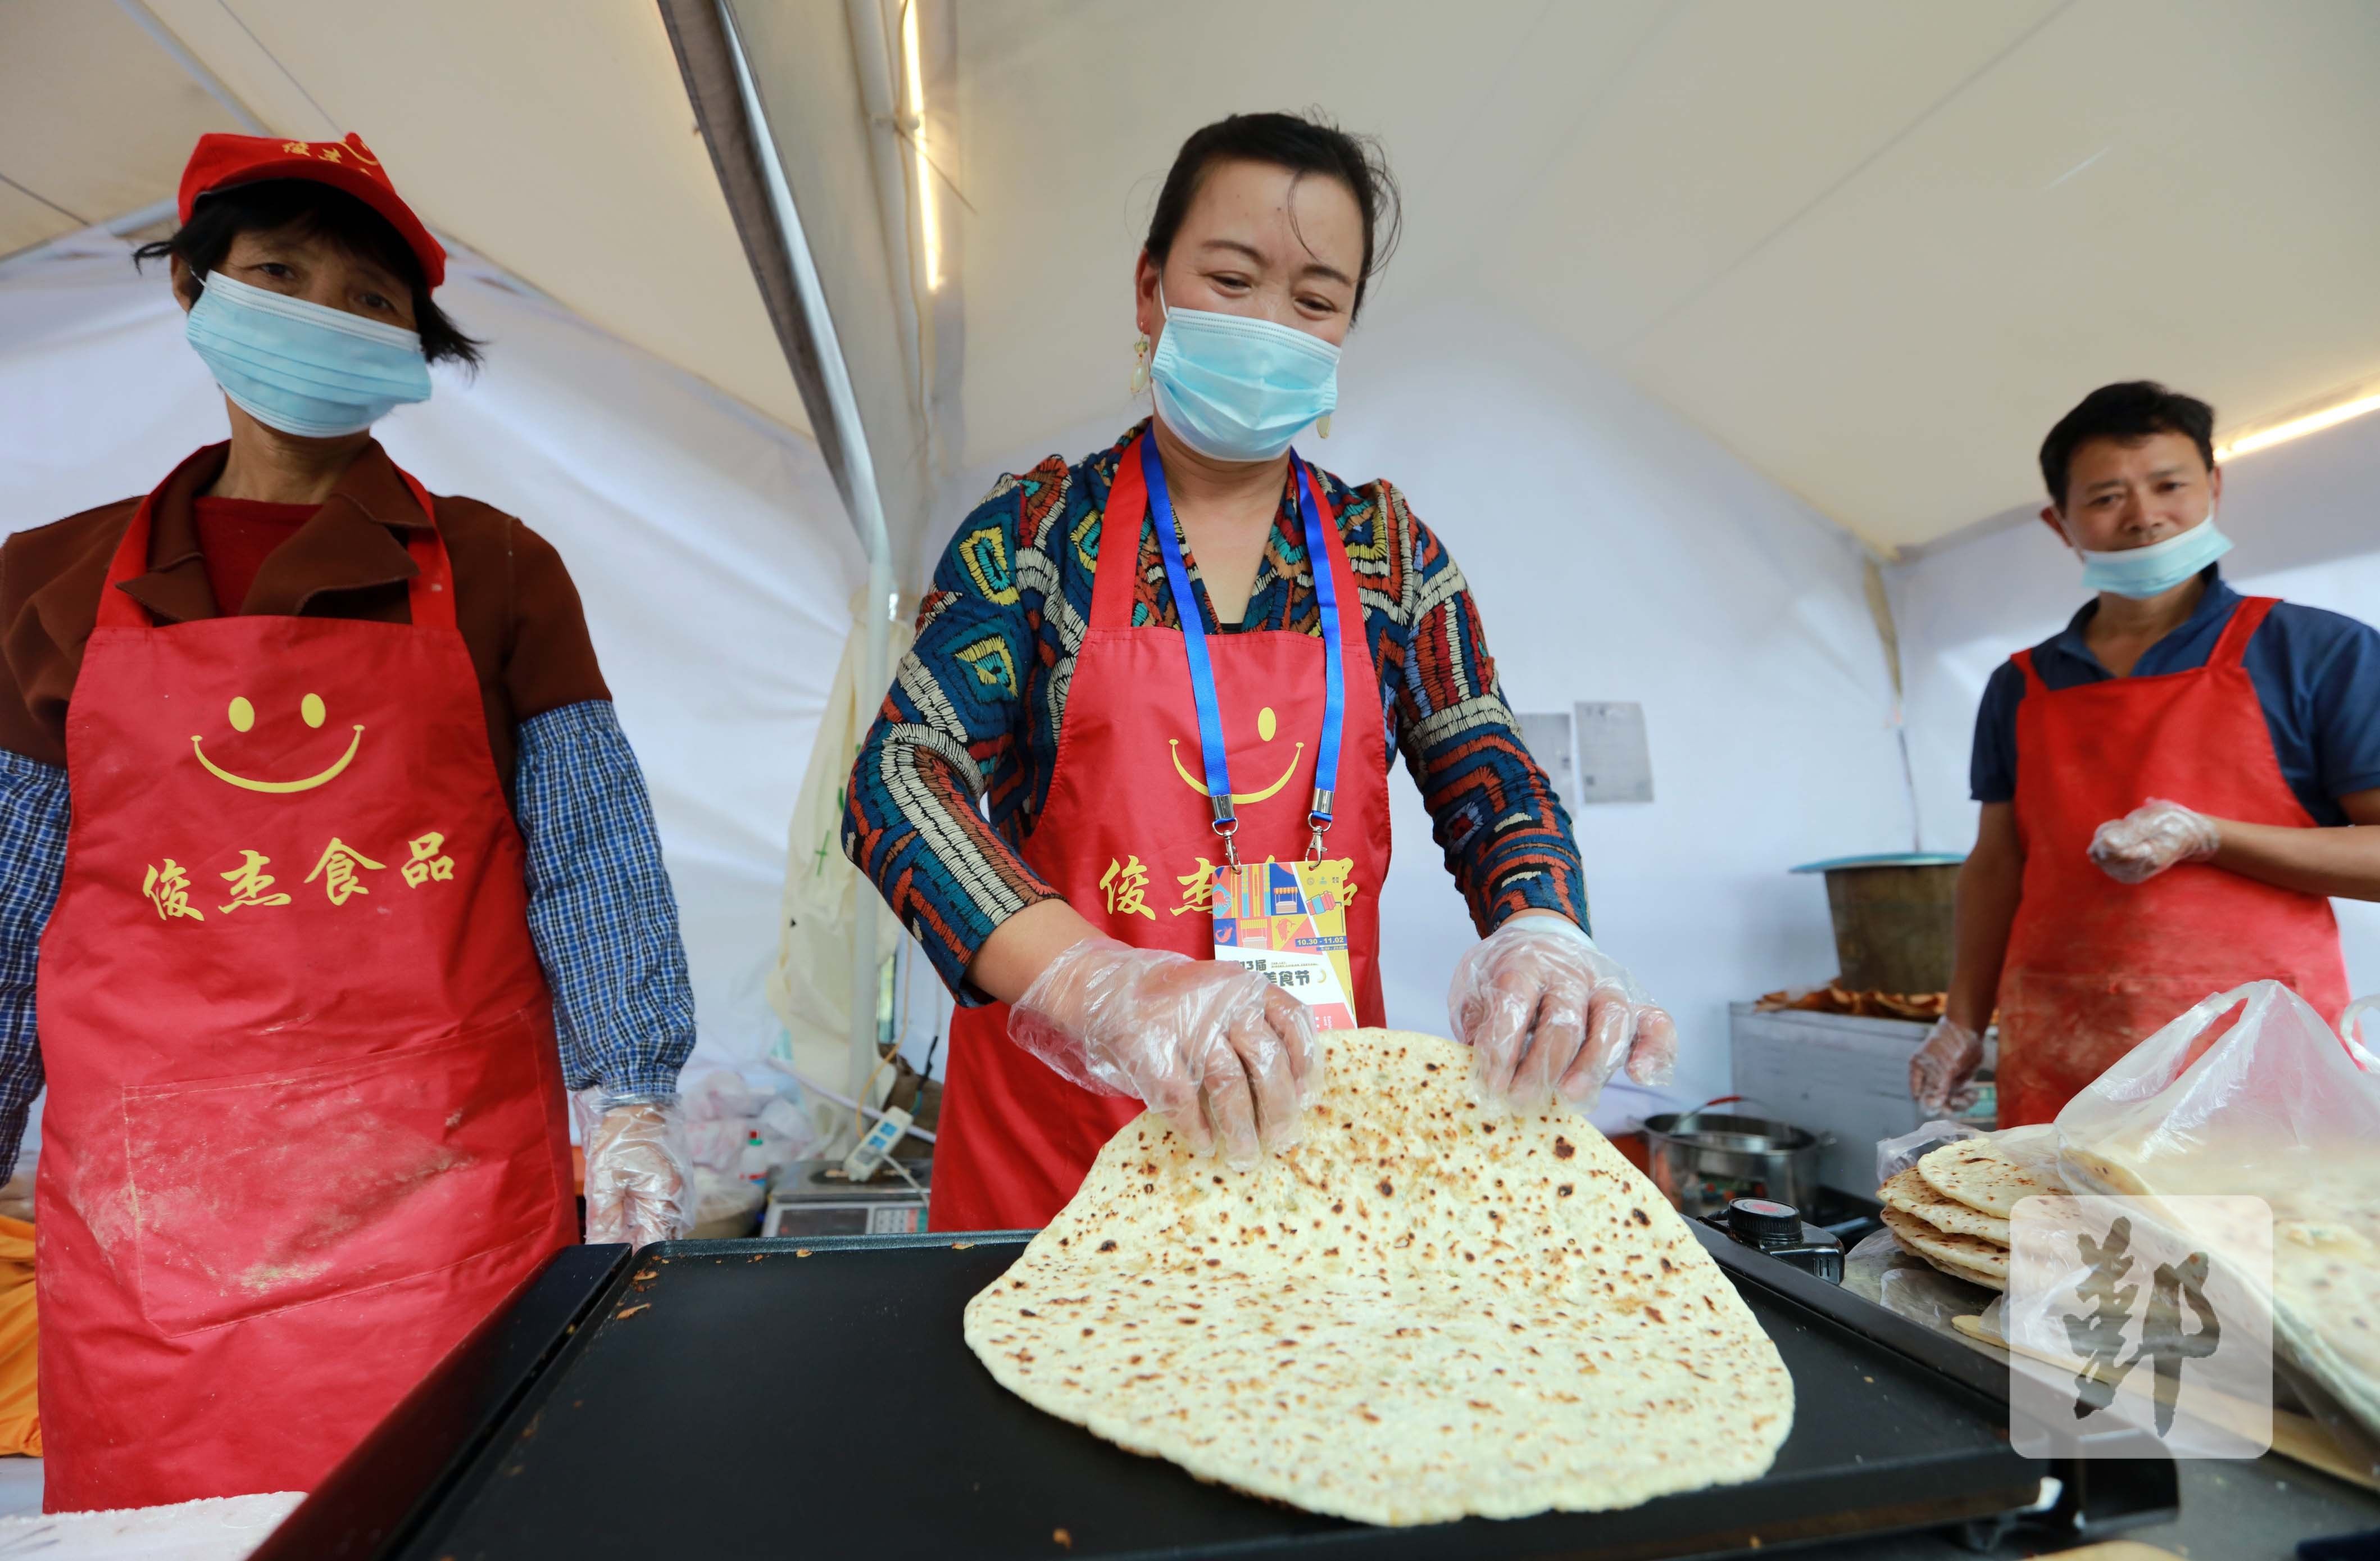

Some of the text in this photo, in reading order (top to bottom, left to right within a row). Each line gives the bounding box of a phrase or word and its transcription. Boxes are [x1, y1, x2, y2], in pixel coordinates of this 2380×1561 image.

[143, 832, 454, 921] 俊杰食品
[1099, 854, 1358, 920] 俊杰
